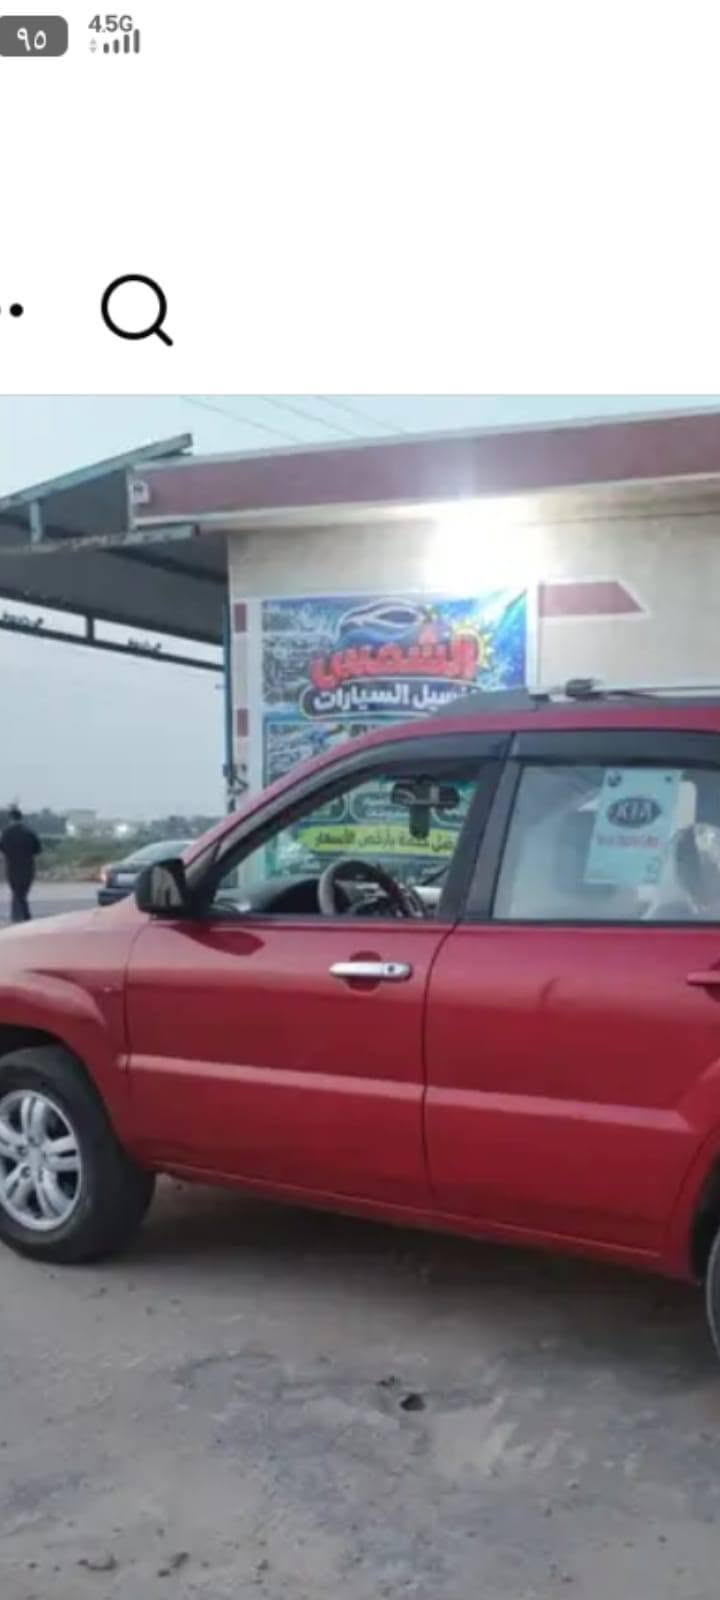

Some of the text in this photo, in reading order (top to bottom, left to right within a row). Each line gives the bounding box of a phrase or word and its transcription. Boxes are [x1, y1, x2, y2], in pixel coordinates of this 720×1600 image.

[310, 624, 476, 690] الشمس
[313, 684, 477, 711] سيل السيارات
